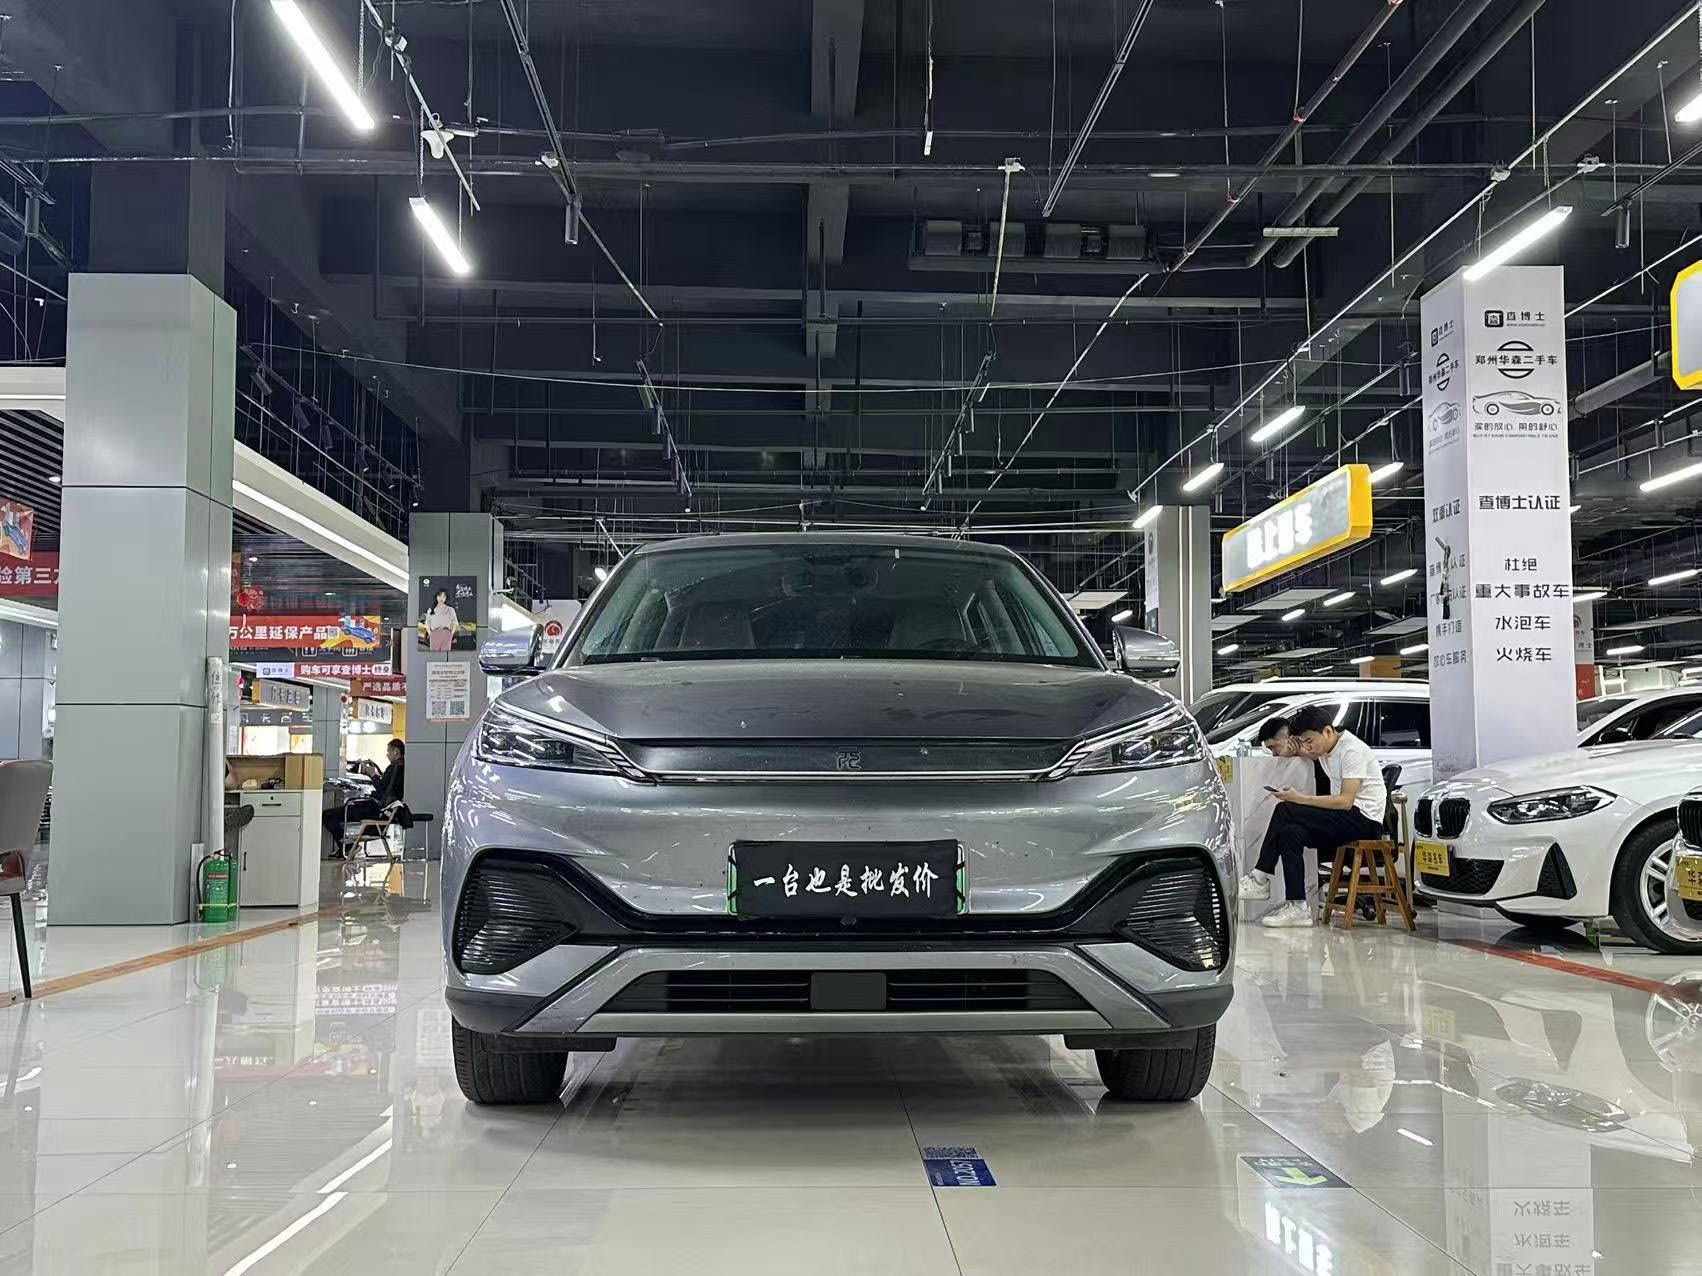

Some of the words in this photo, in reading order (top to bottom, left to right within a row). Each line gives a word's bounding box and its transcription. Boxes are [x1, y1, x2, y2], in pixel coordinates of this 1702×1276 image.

[1506, 311, 1545, 321] 查博士
[1475, 354, 1558, 365] 郑州华森二手车
[1479, 495, 1560, 510] 查博士认证
[1504, 558, 1537, 572] 杜绝
[1475, 584, 1569, 599] 重大事故车
[1495, 615, 1551, 630] 水泡车
[1496, 647, 1552, 662] 火烧车
[753, 862, 939, 898] 一台也是批发价
